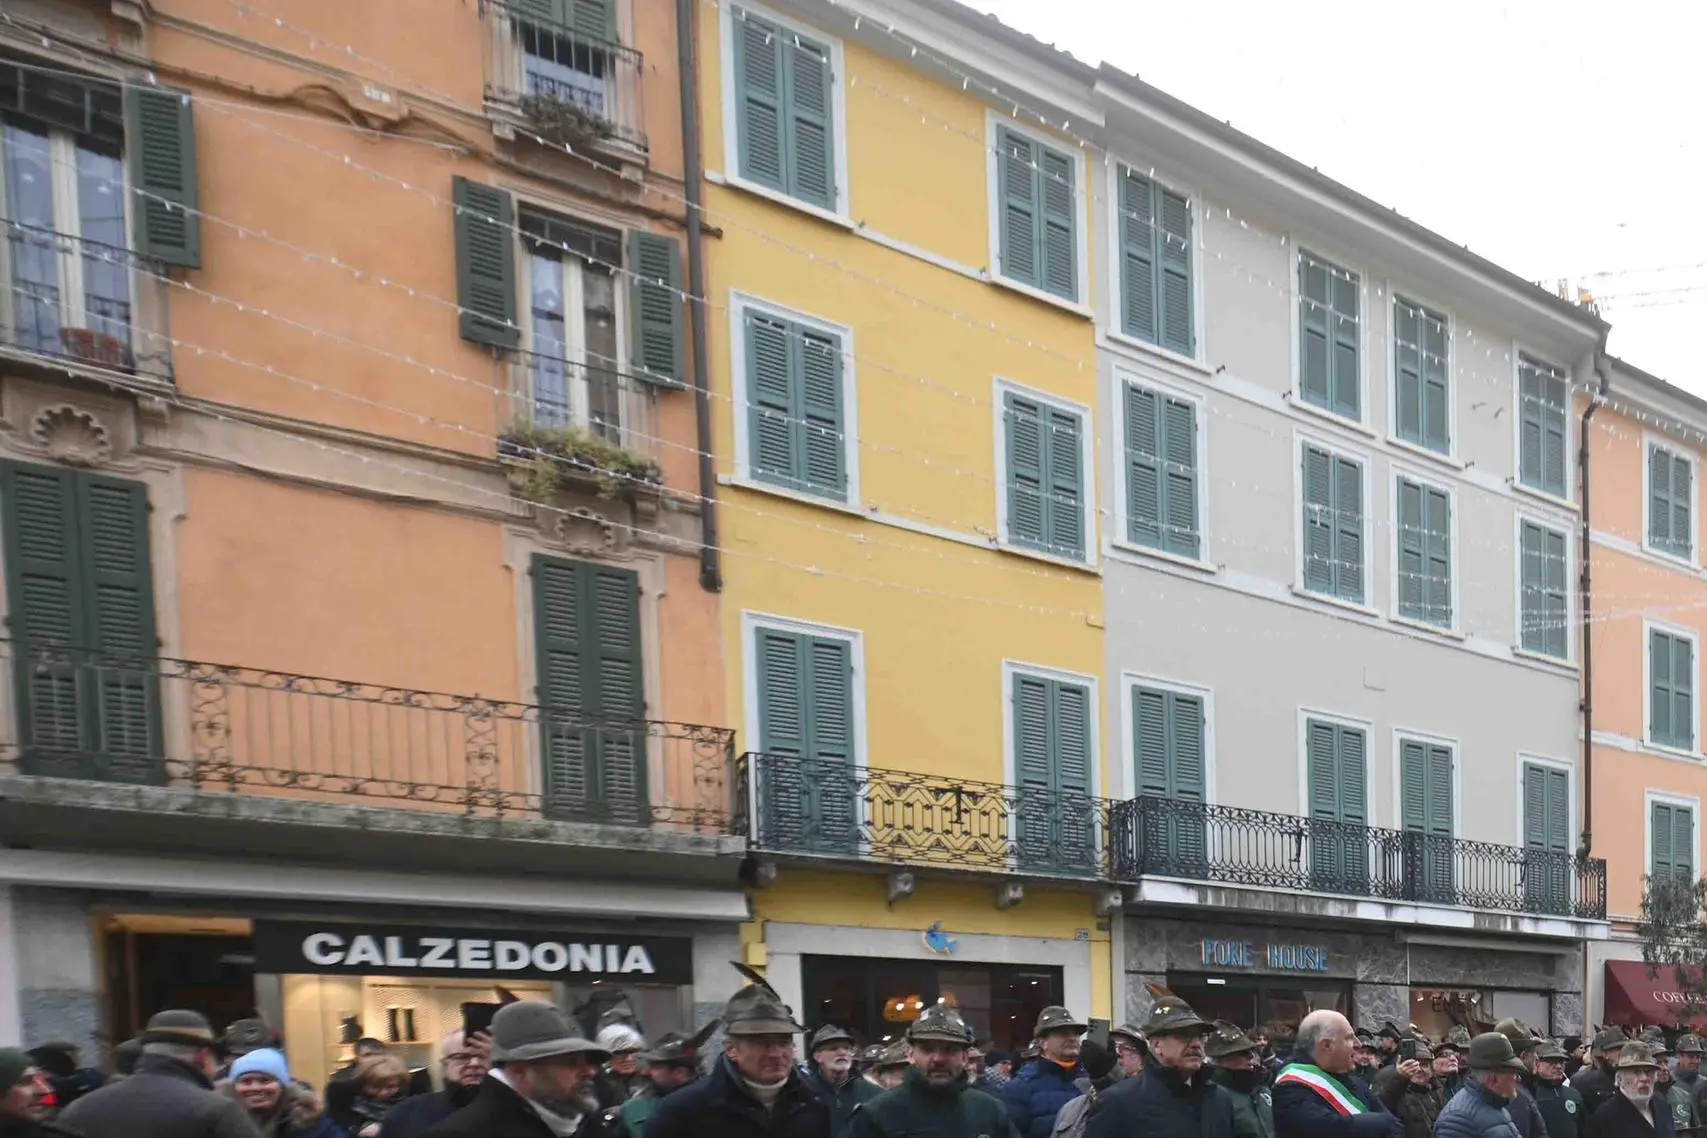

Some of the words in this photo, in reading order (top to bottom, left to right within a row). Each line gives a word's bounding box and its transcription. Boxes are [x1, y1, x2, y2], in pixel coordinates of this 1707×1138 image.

[302, 932, 656, 974] CALZEDONIA
[1201, 936, 1253, 967] POKE
[1266, 943, 1329, 971] HOUSE
